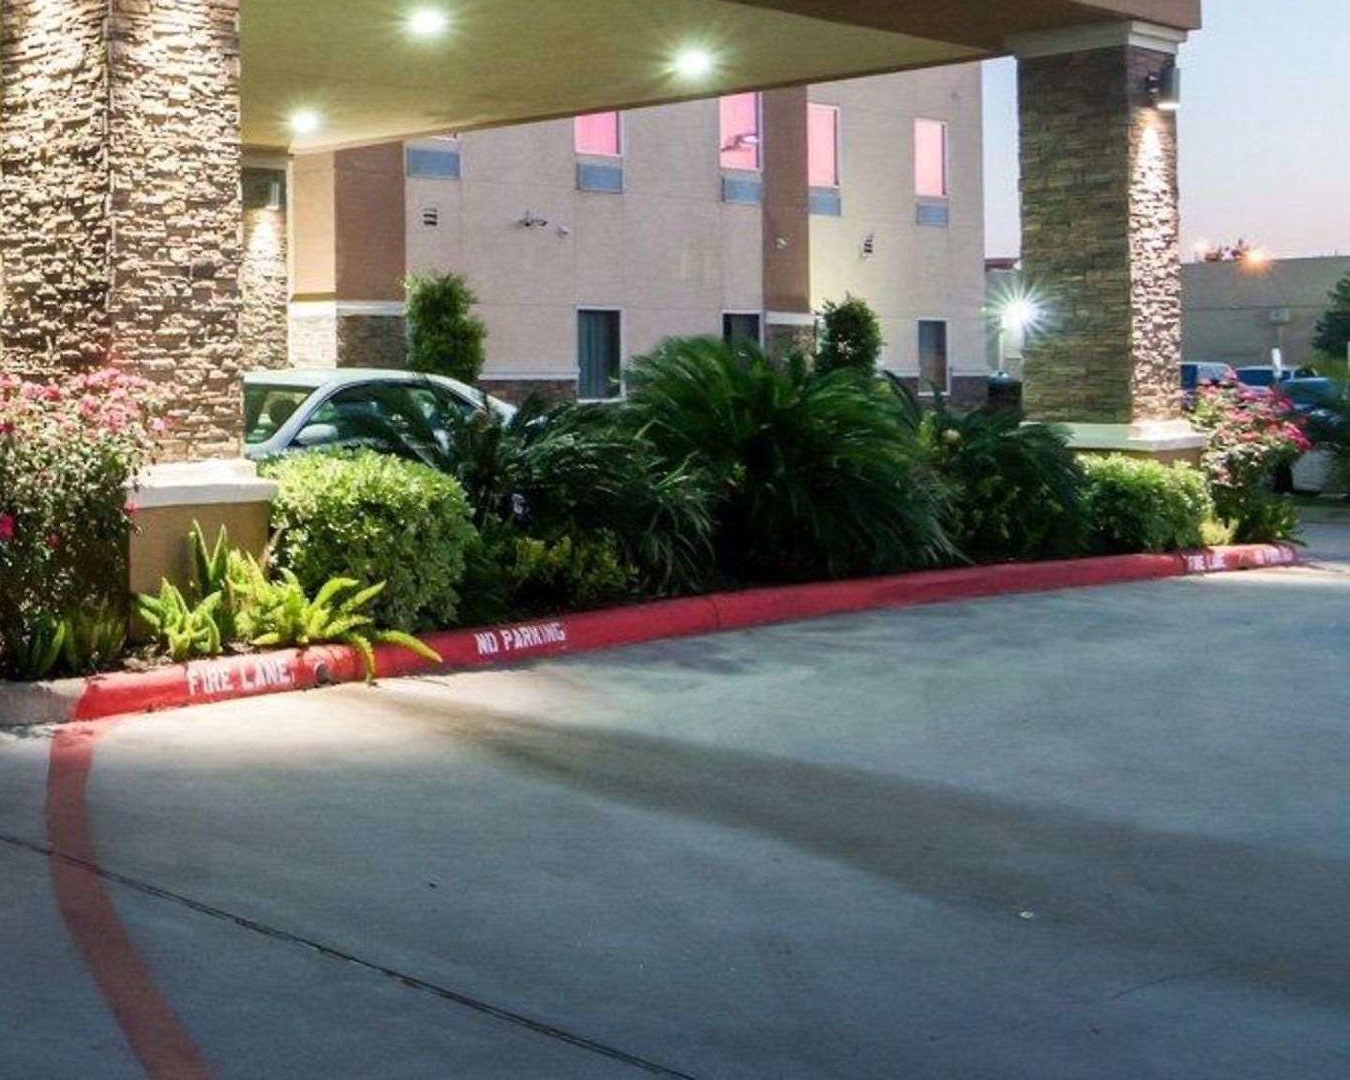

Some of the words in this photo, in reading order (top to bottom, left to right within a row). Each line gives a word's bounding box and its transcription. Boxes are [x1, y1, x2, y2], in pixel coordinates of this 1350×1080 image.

[474, 632, 499, 654] NO
[500, 622, 566, 651] PARKING
[187, 660, 234, 696] FIRE
[240, 658, 295, 690] LANE
